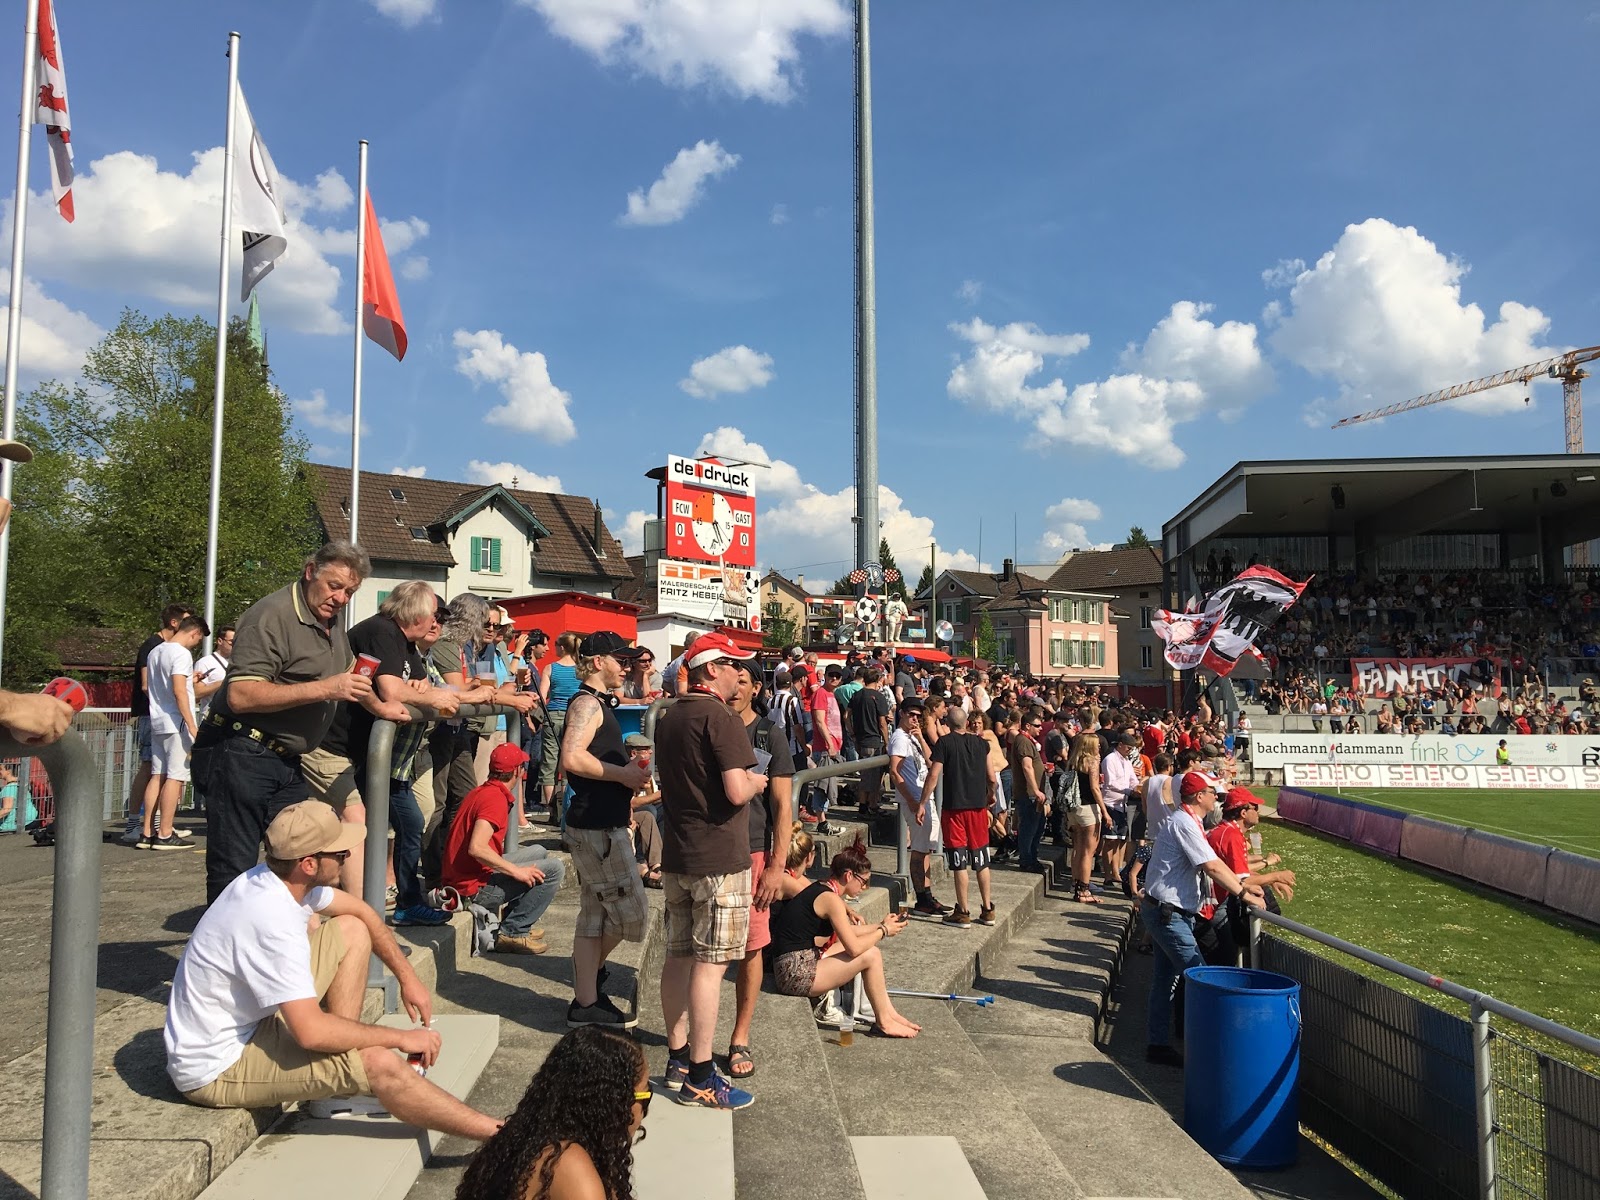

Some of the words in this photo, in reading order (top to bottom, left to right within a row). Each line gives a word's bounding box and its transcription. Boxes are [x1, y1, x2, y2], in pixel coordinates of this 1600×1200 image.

[675, 502, 690, 515] FCW
[696, 517, 703, 526] 45
[735, 512, 751, 525] GAST
[677, 523, 684, 536] 0
[741, 533, 748, 546] 0
[660, 587, 688, 597] FRITZ
[692, 590, 725, 600] HEBEIS
[1256, 742, 1328, 754] bachmann
[1335, 742, 1404, 755] dammann
[1410, 740, 1449, 761] fink
